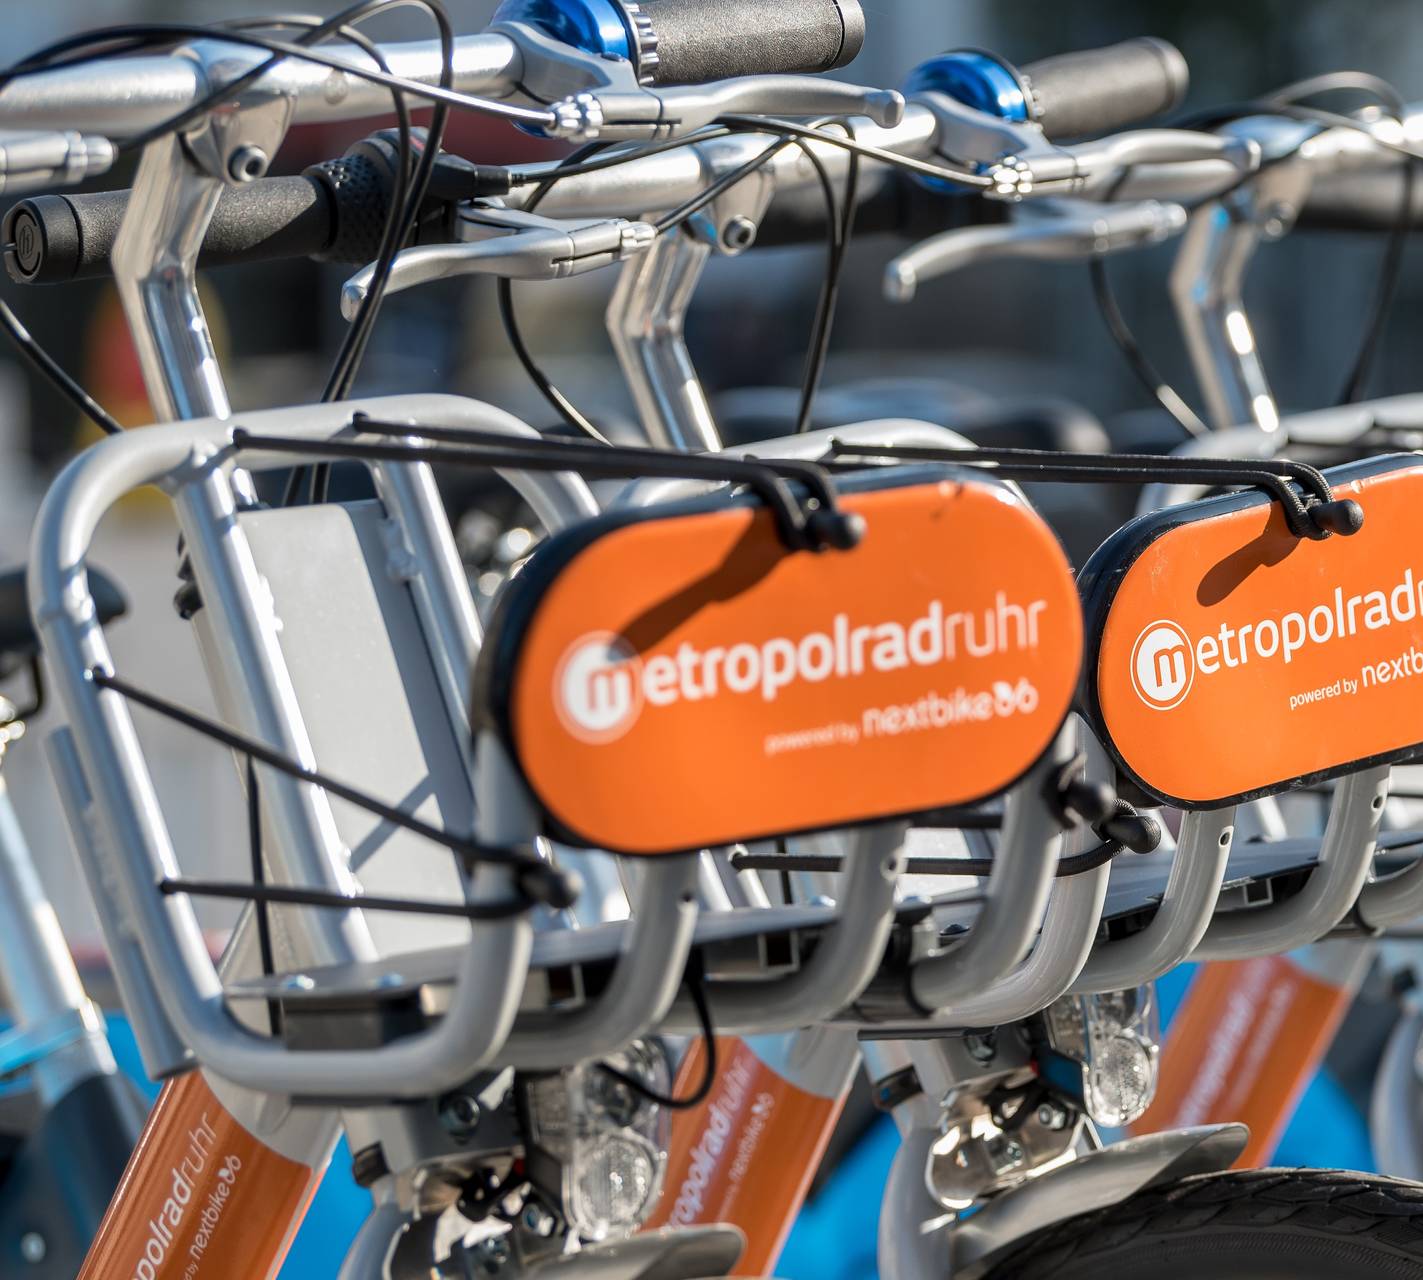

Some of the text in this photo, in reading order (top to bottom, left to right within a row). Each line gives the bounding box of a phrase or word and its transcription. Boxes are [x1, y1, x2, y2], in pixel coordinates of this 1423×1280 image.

[553, 590, 1048, 744] metropolradruhr
[1289, 680, 1342, 710] powered
[1343, 678, 1359, 694] by
[862, 686, 993, 737] nextbike
[189, 1182, 231, 1260] nextbike
